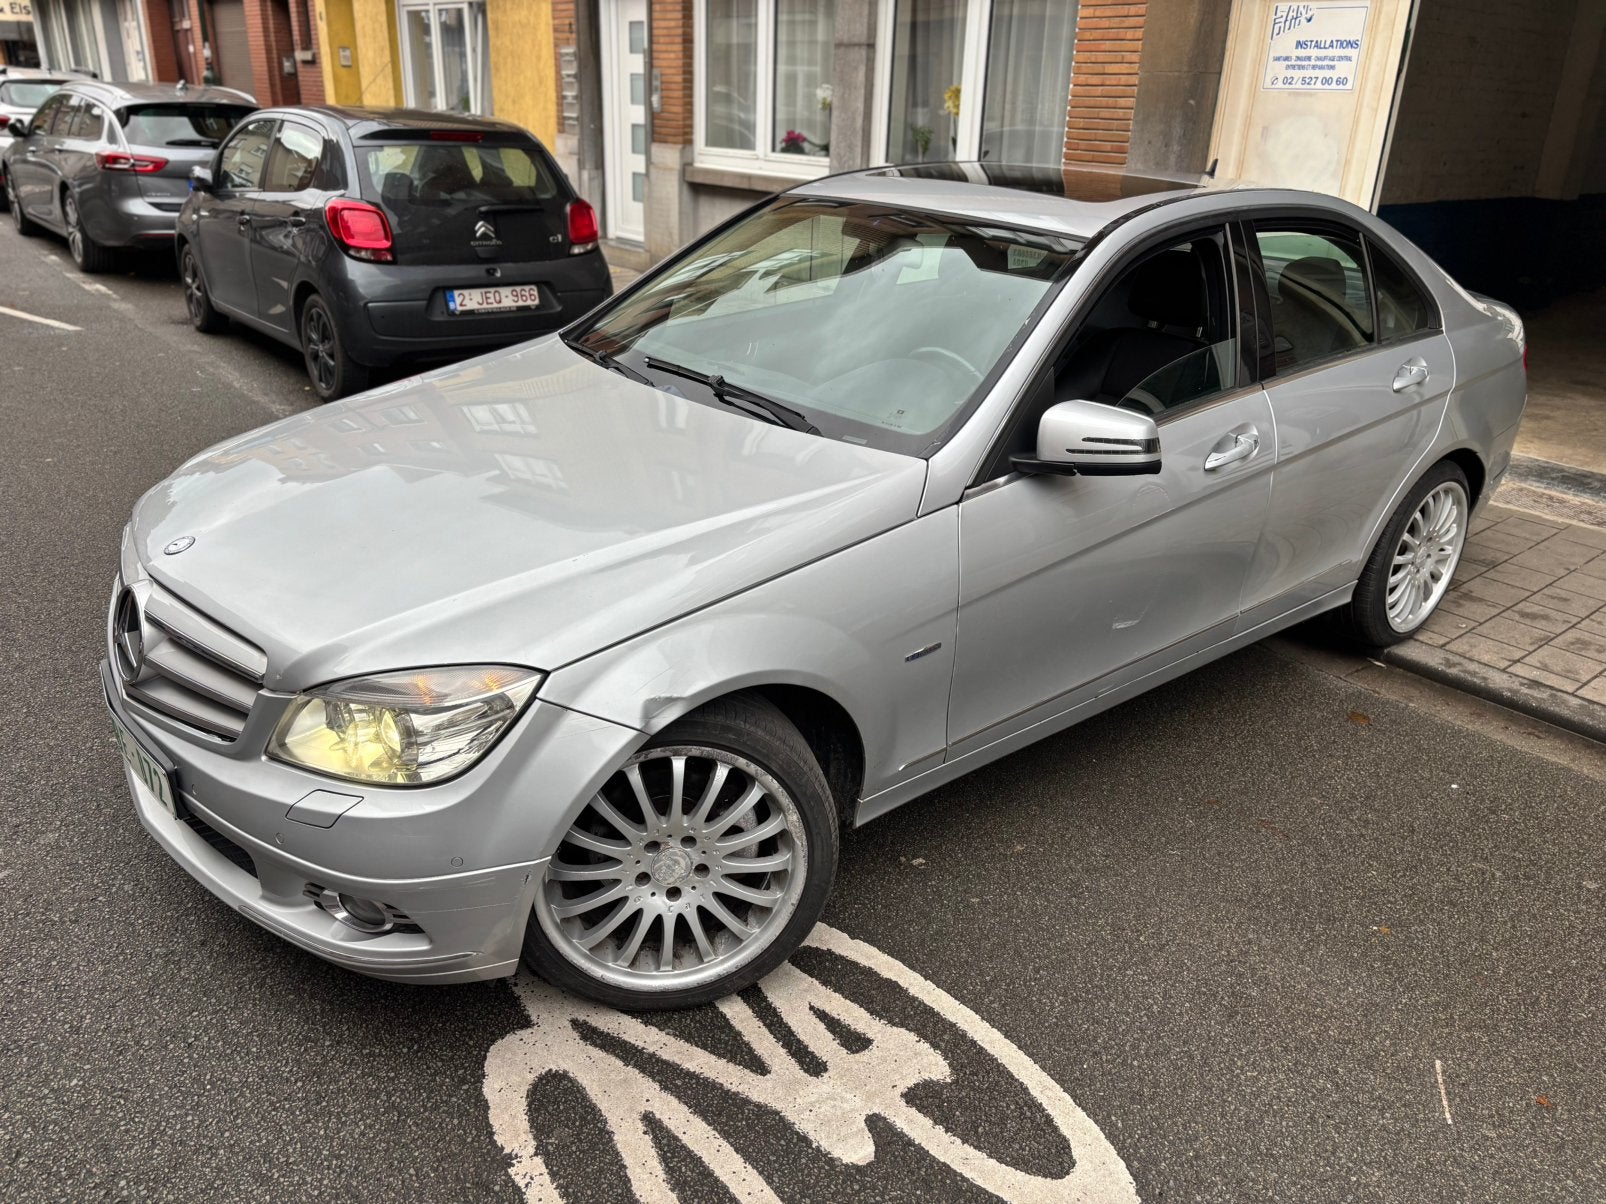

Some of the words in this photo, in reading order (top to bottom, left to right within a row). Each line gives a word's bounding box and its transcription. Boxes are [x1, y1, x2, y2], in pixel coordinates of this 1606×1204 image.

[1295, 39, 1360, 50] INSTALLATIONS
[1321, 76, 1334, 86] 00
[1335, 76, 1348, 86] 60
